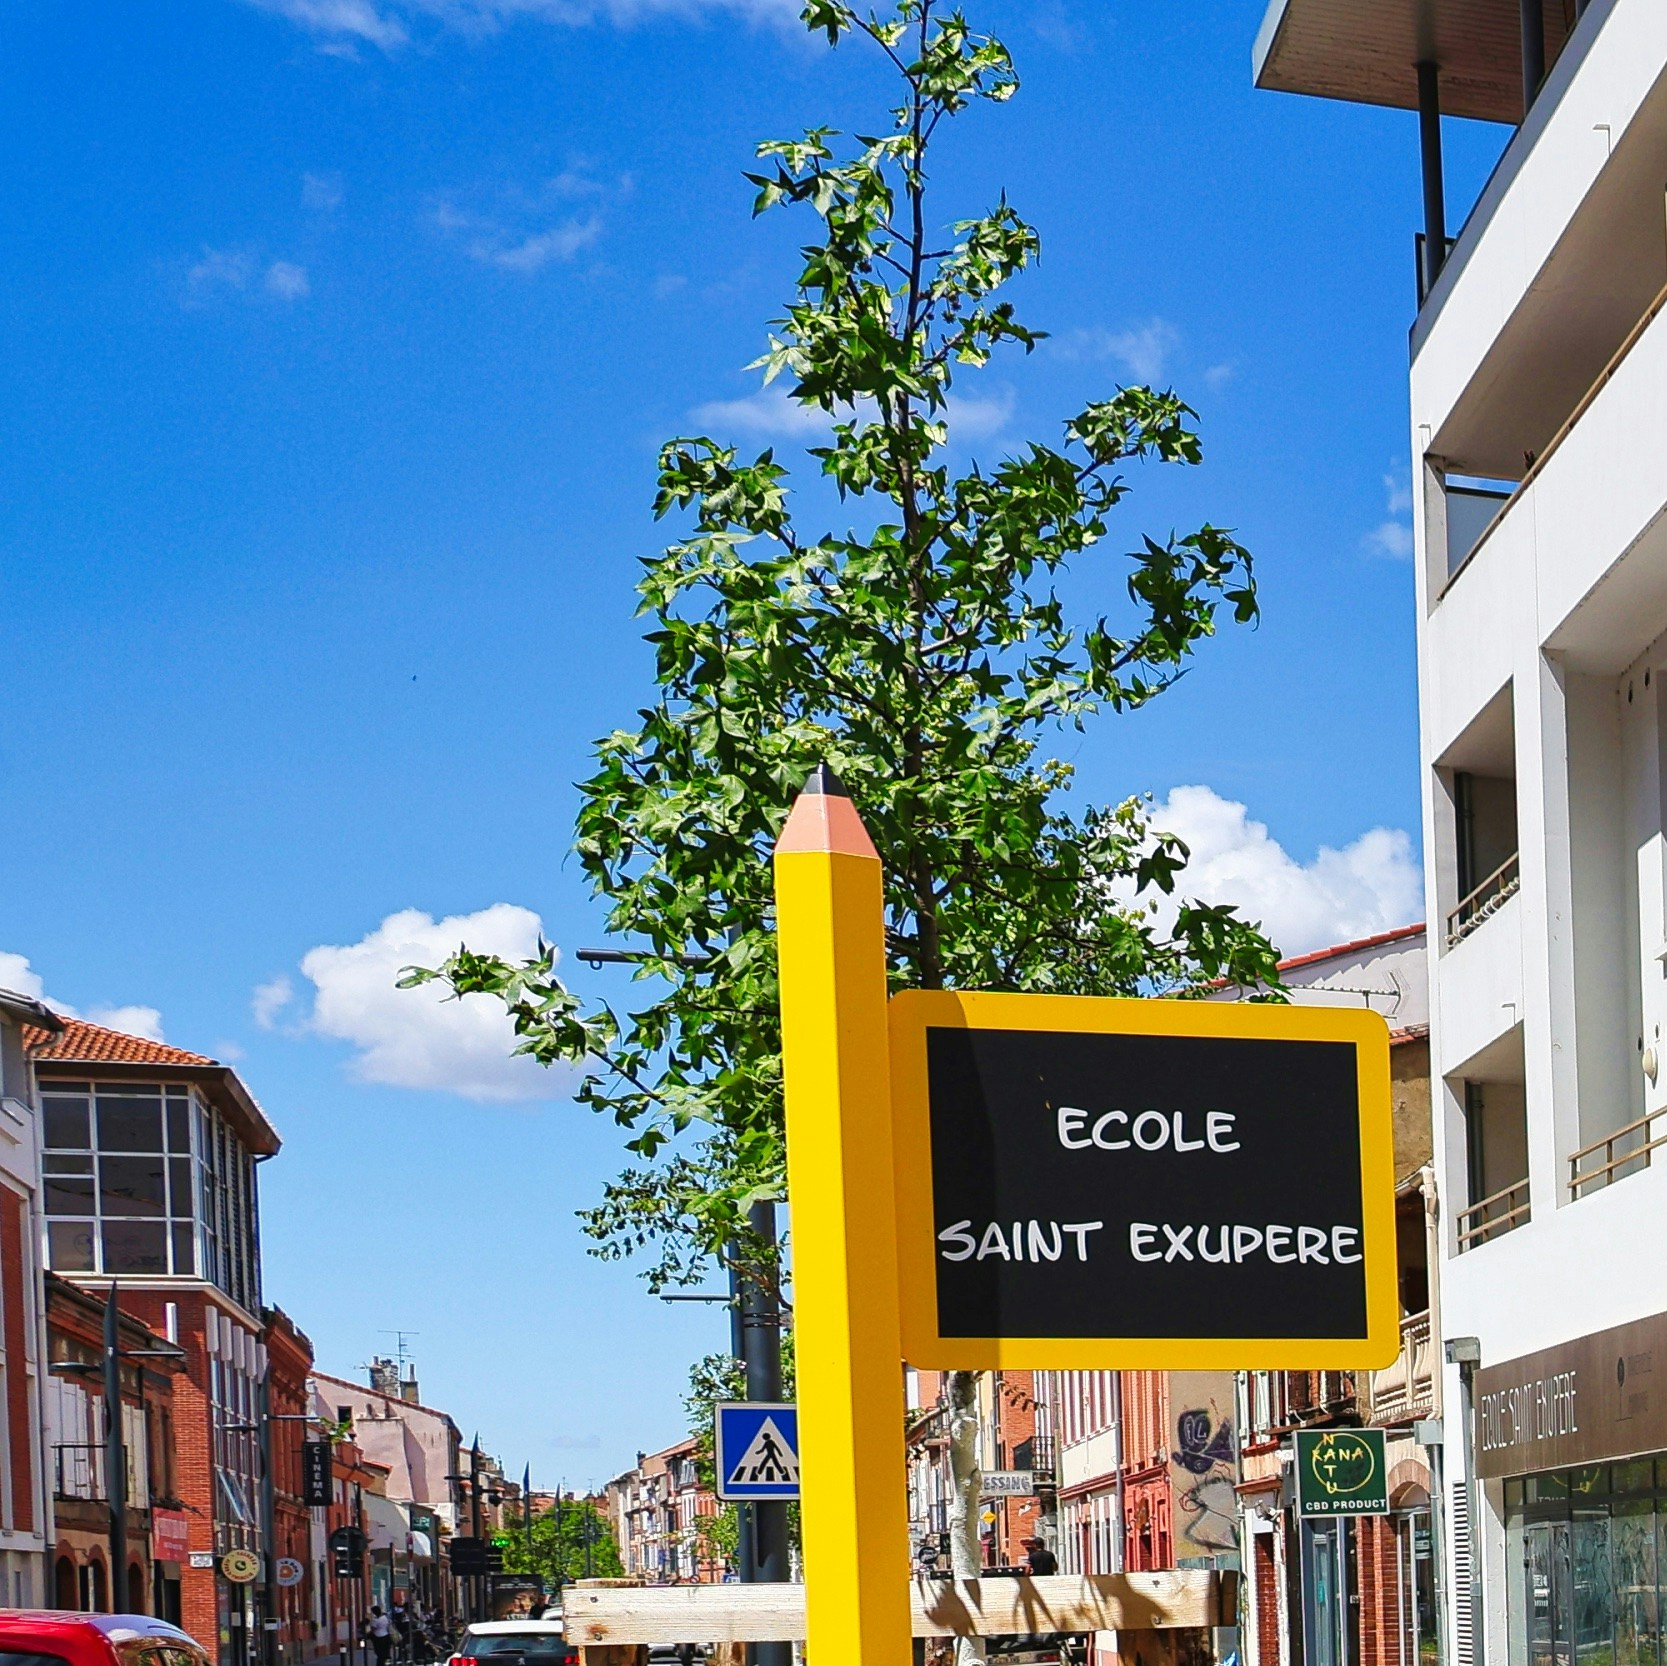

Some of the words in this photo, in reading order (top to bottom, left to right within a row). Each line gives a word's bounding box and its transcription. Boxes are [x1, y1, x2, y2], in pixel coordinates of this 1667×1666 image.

[1056, 1106, 1241, 1153] ECOLE
[937, 1219, 1104, 1263] SAINT
[1129, 1222, 1363, 1265] EXUPERE
[313, 1446, 323, 1498] CINEMA
[1305, 1501, 1329, 1511] CBD
[1332, 1498, 1387, 1510] PRODUCT
